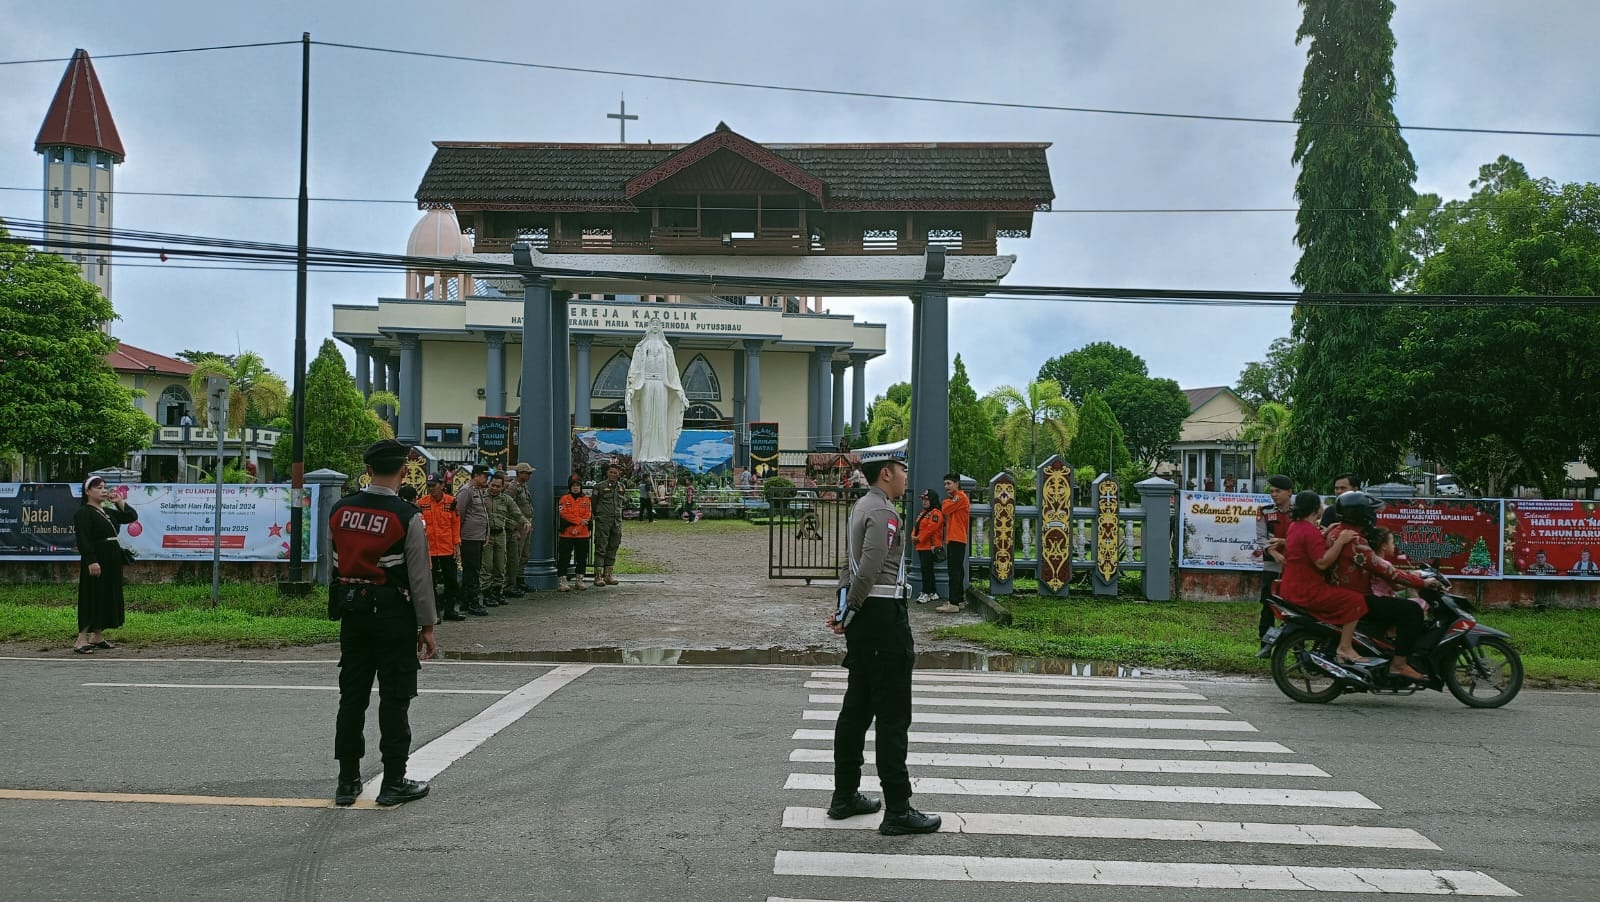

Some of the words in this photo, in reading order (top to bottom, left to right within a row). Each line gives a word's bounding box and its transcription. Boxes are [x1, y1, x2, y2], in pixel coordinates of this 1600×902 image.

[571, 308, 618, 318] EREJA
[632, 310, 696, 320] KATOLIK
[696, 323, 742, 331] PUTUSSIBAU
[22, 505, 53, 522] Natal
[1192, 504, 1231, 515] Selamat
[341, 511, 388, 533] POLISI
[1215, 516, 1239, 524] 2024
[33, 525, 51, 533] Tahun
